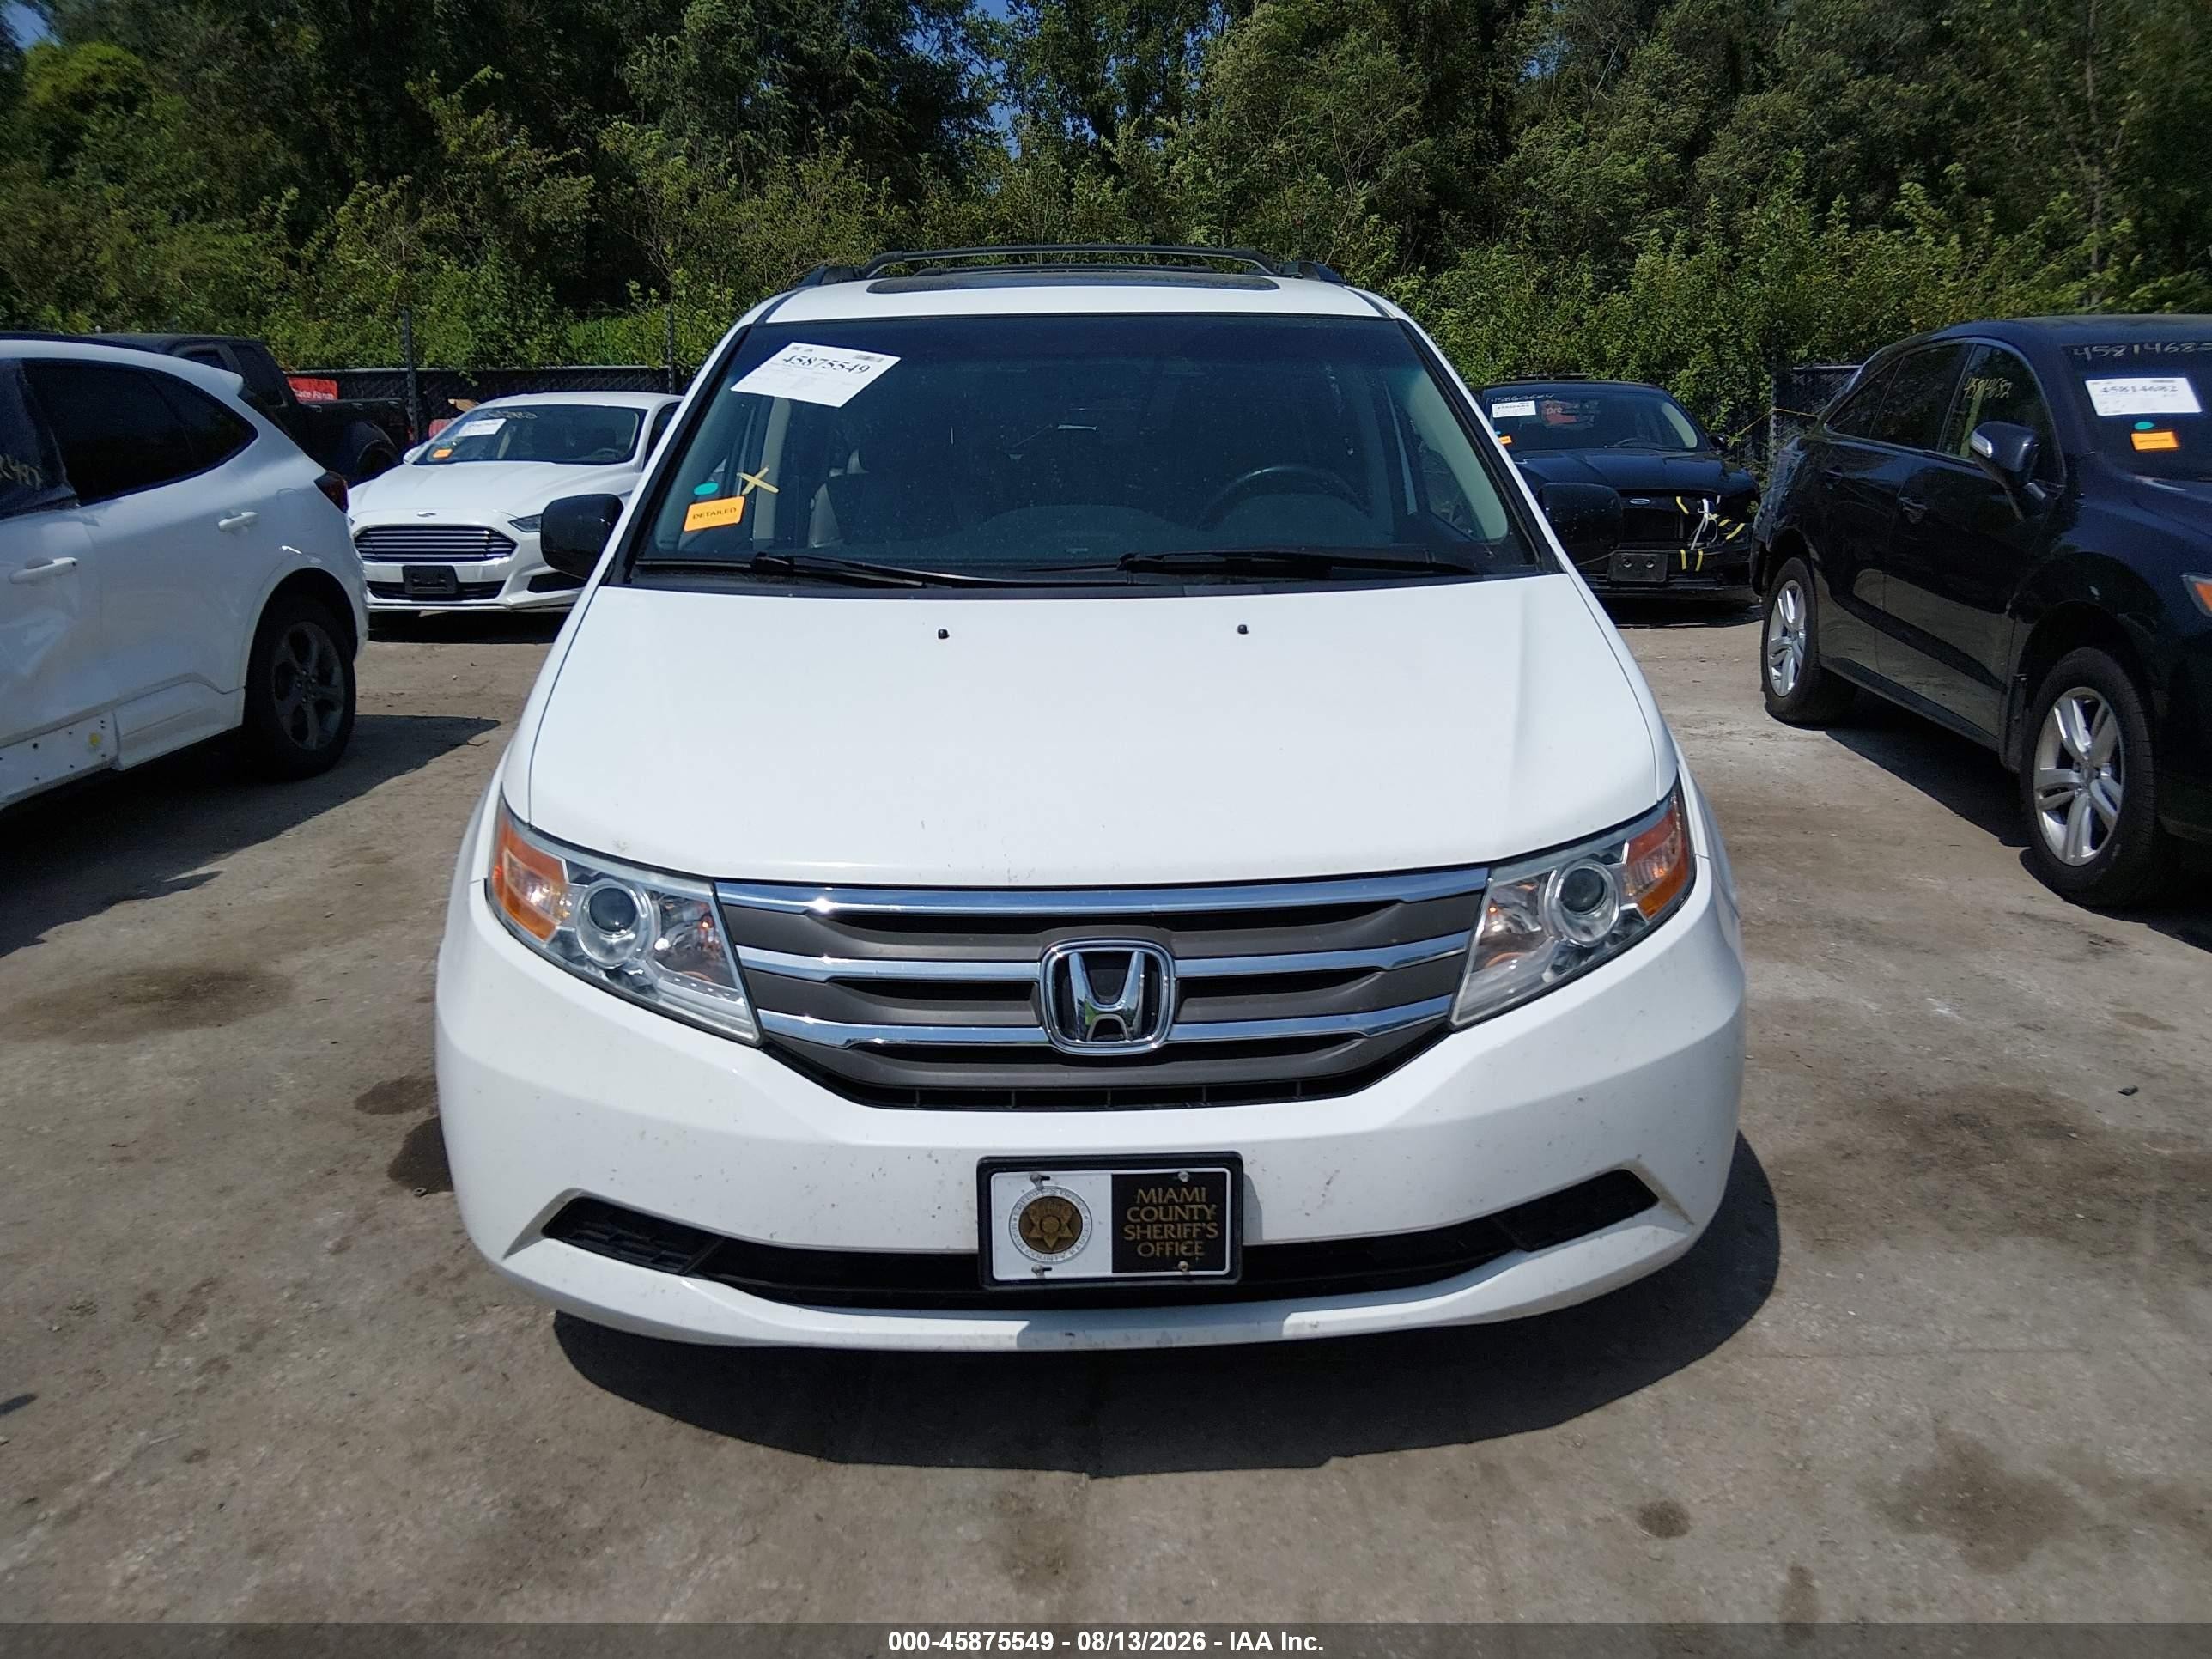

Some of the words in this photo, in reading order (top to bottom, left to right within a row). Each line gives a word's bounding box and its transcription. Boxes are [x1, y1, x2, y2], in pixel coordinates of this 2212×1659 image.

[782, 354, 870, 374] 45875549
[692, 507, 738, 520] DETAILED
[1136, 1187, 1206, 1204] MIAMI
[1126, 1204, 1218, 1223] COUNTY
[1123, 1222, 1219, 1242] SHERIFF'S
[1137, 1241, 1206, 1257] OFFICE
